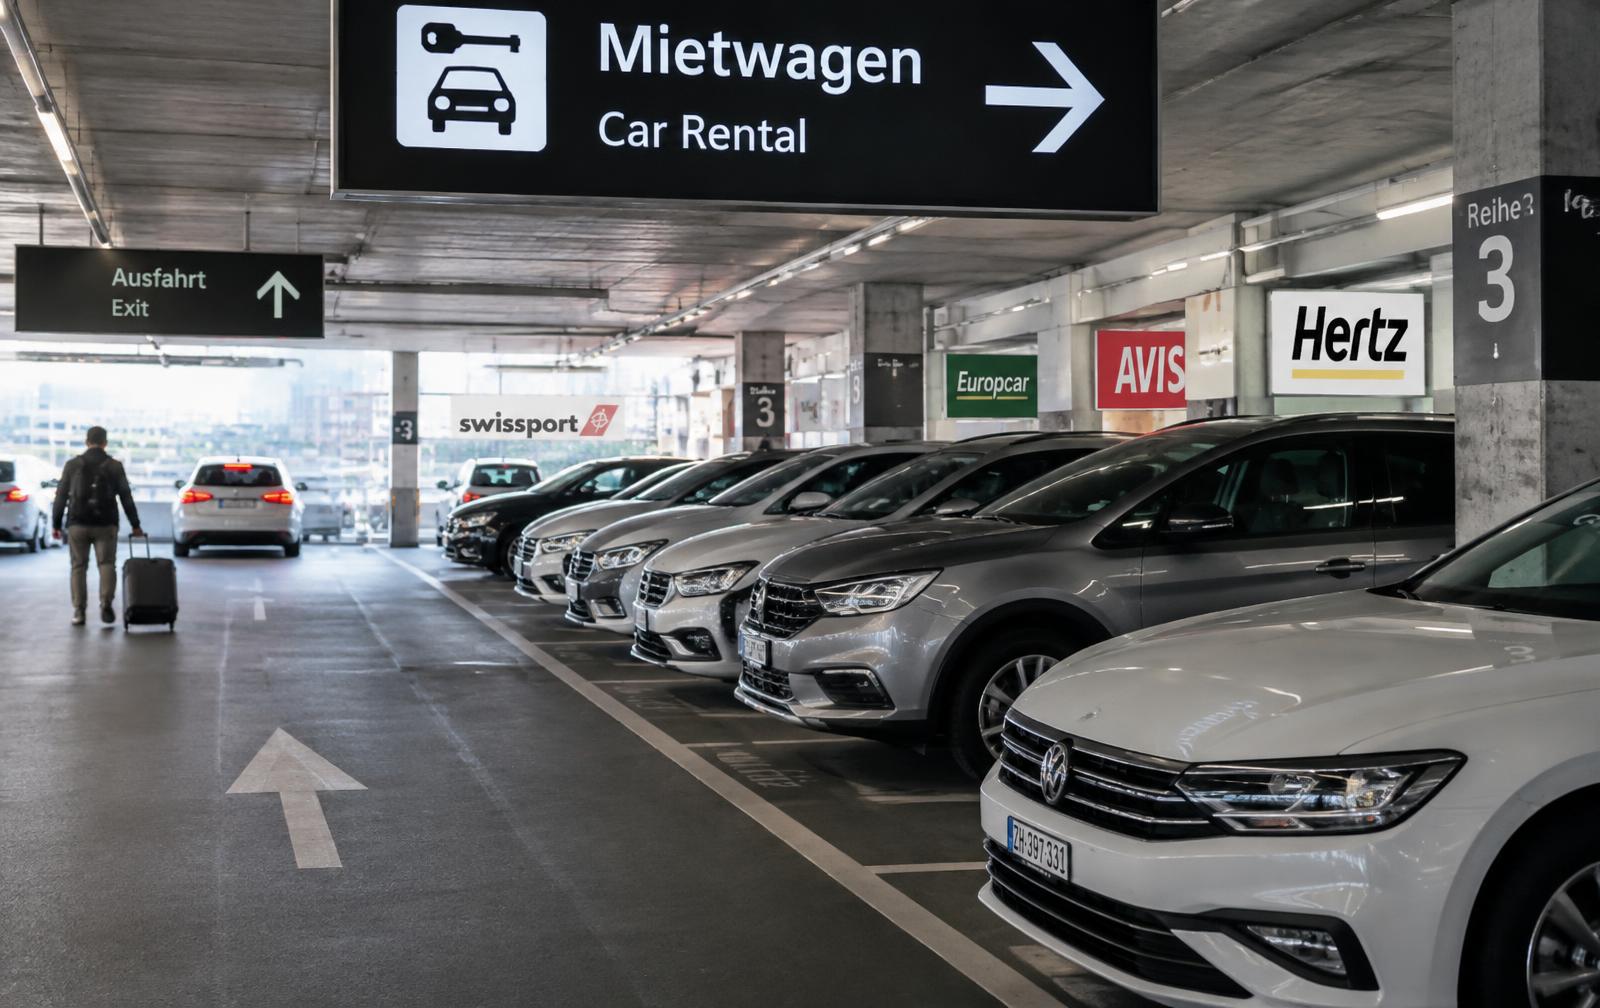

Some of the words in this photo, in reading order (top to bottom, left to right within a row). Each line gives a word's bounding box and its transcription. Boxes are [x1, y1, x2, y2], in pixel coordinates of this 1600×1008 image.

[600, 22, 922, 95] Mietwagen
[598, 111, 668, 148] Car
[682, 114, 806, 153] Rental
[1467, 196, 1521, 229] Reihe
[111, 267, 207, 289] Ausfahrt
[1478, 234, 1516, 323] 3
[111, 299, 149, 317] Exit
[1291, 306, 1409, 362] Hertz
[956, 370, 1030, 400] Europcar
[1114, 345, 1186, 394] AVIS
[459, 411, 578, 438] swissport
[756, 397, 776, 428] 3
